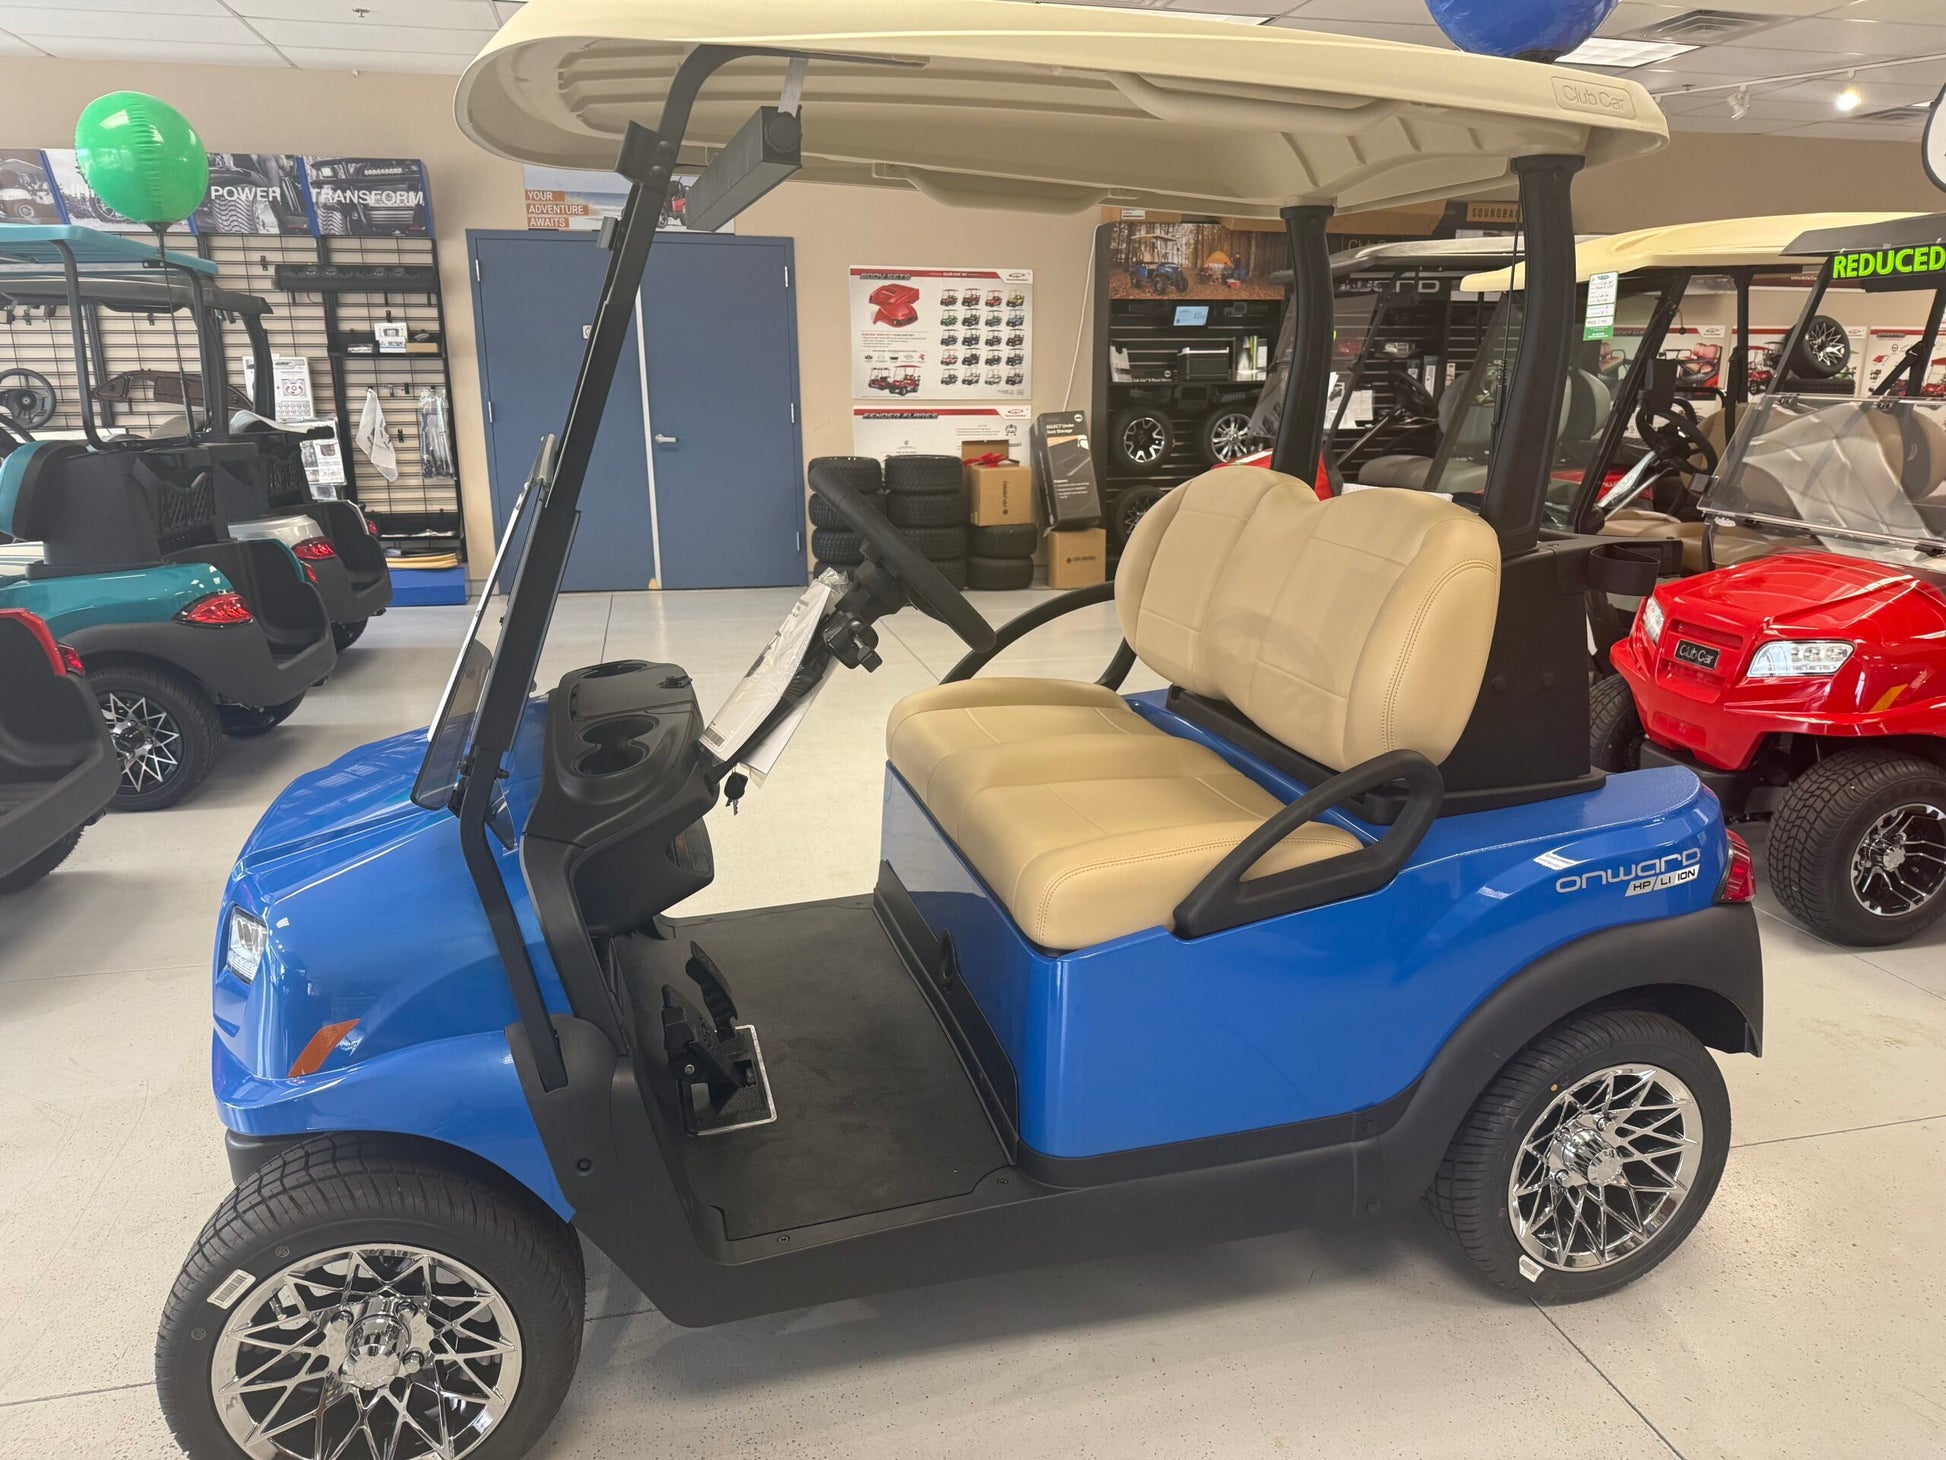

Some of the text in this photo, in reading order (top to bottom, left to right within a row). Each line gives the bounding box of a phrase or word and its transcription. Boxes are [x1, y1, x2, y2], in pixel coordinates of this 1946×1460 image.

[1563, 84, 1625, 111] Club Car
[210, 185, 282, 202] POWER
[311, 188, 424, 206] TRANSFORM
[527, 190, 554, 201] YOUR
[528, 204, 584, 215] ADVENTURE
[529, 217, 566, 228] AWAITS
[1832, 245, 1946, 279] REDUCED
[1679, 644, 1714, 664] Club Car
[1633, 880, 1651, 892] HP
[1677, 868, 1696, 882] ION
